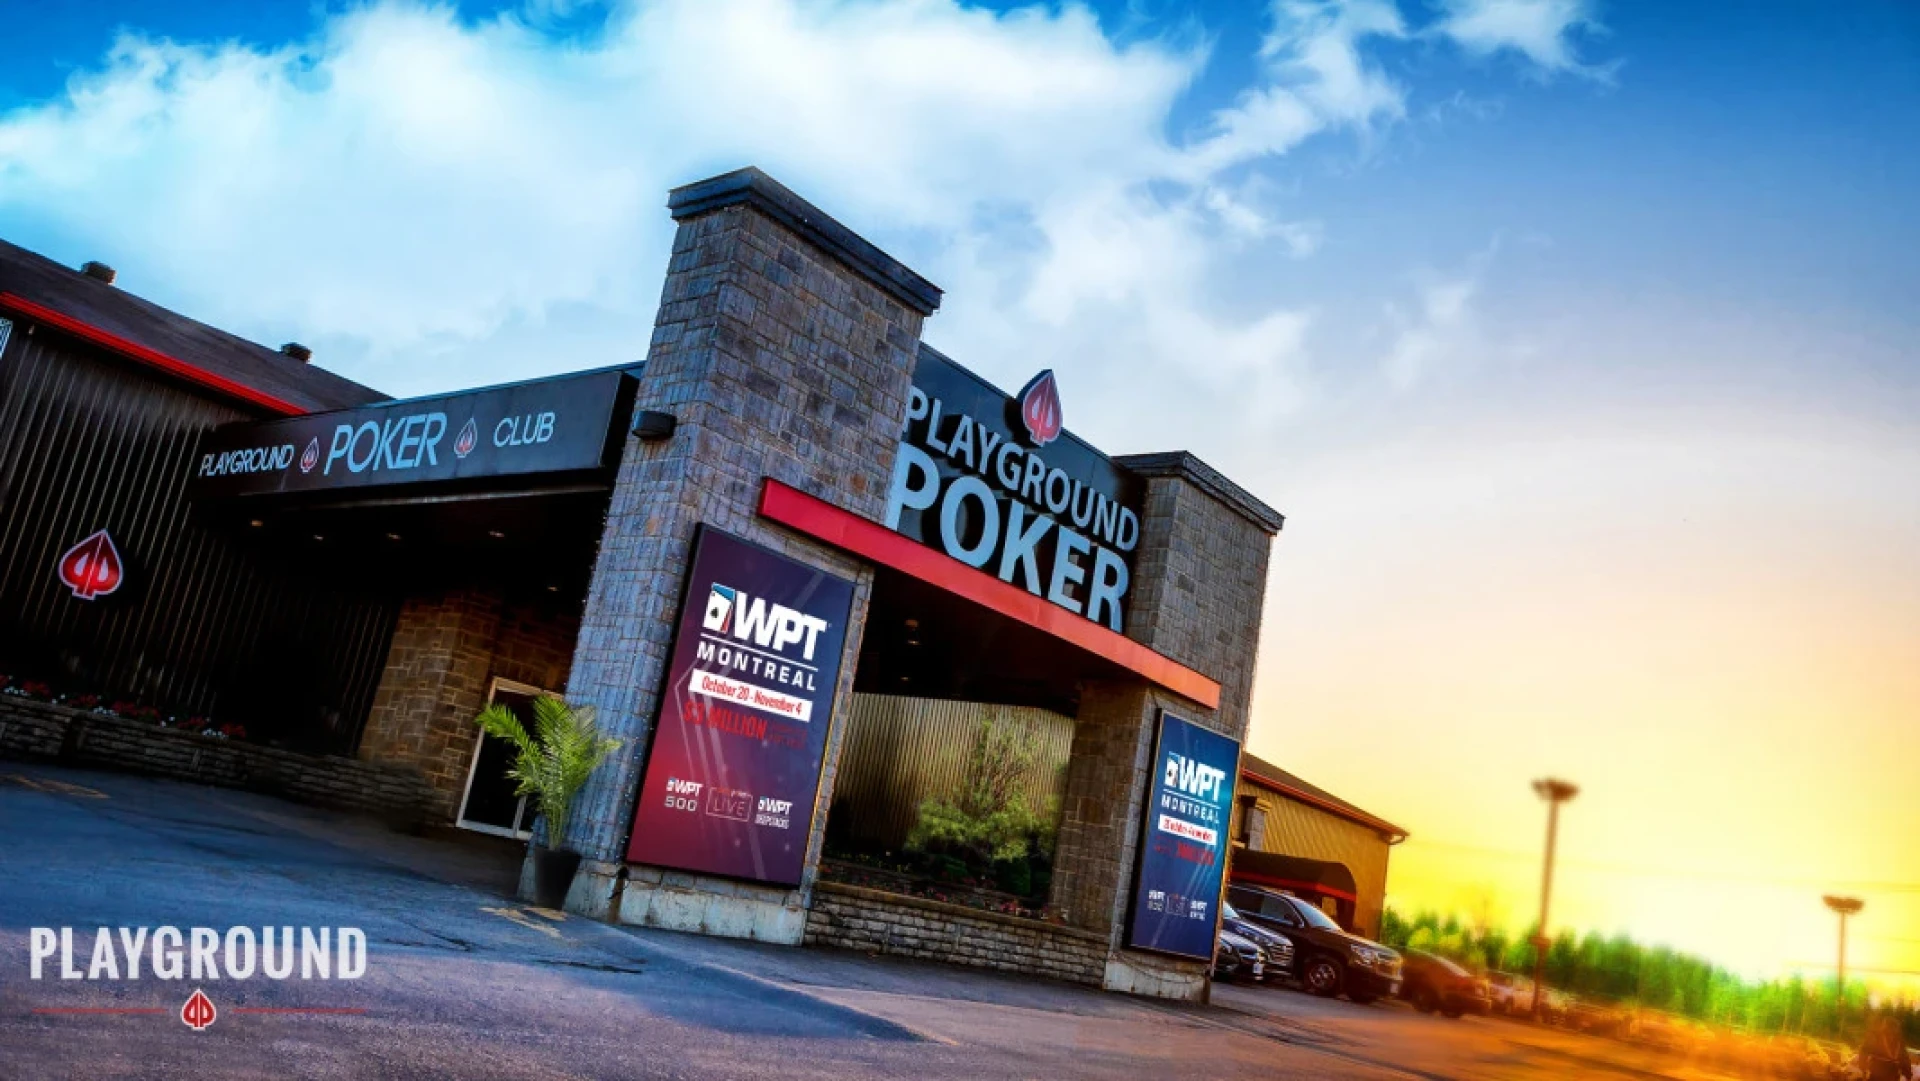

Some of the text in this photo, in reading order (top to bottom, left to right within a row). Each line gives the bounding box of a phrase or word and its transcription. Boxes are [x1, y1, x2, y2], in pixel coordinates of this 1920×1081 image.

[200, 411, 555, 476] PLAYGROUND POKER CLUB
[901, 385, 1139, 552] PLAYGROUND
[884, 441, 1130, 634] POKER
[734, 590, 827, 661] WPT
[697, 641, 816, 691] MONTREAL
[702, 676, 737, 698] October
[737, 686, 750, 701] 20
[755, 690, 795, 713] November
[1179, 755, 1225, 802] WPT
[1161, 794, 1220, 824] MONTREAL
